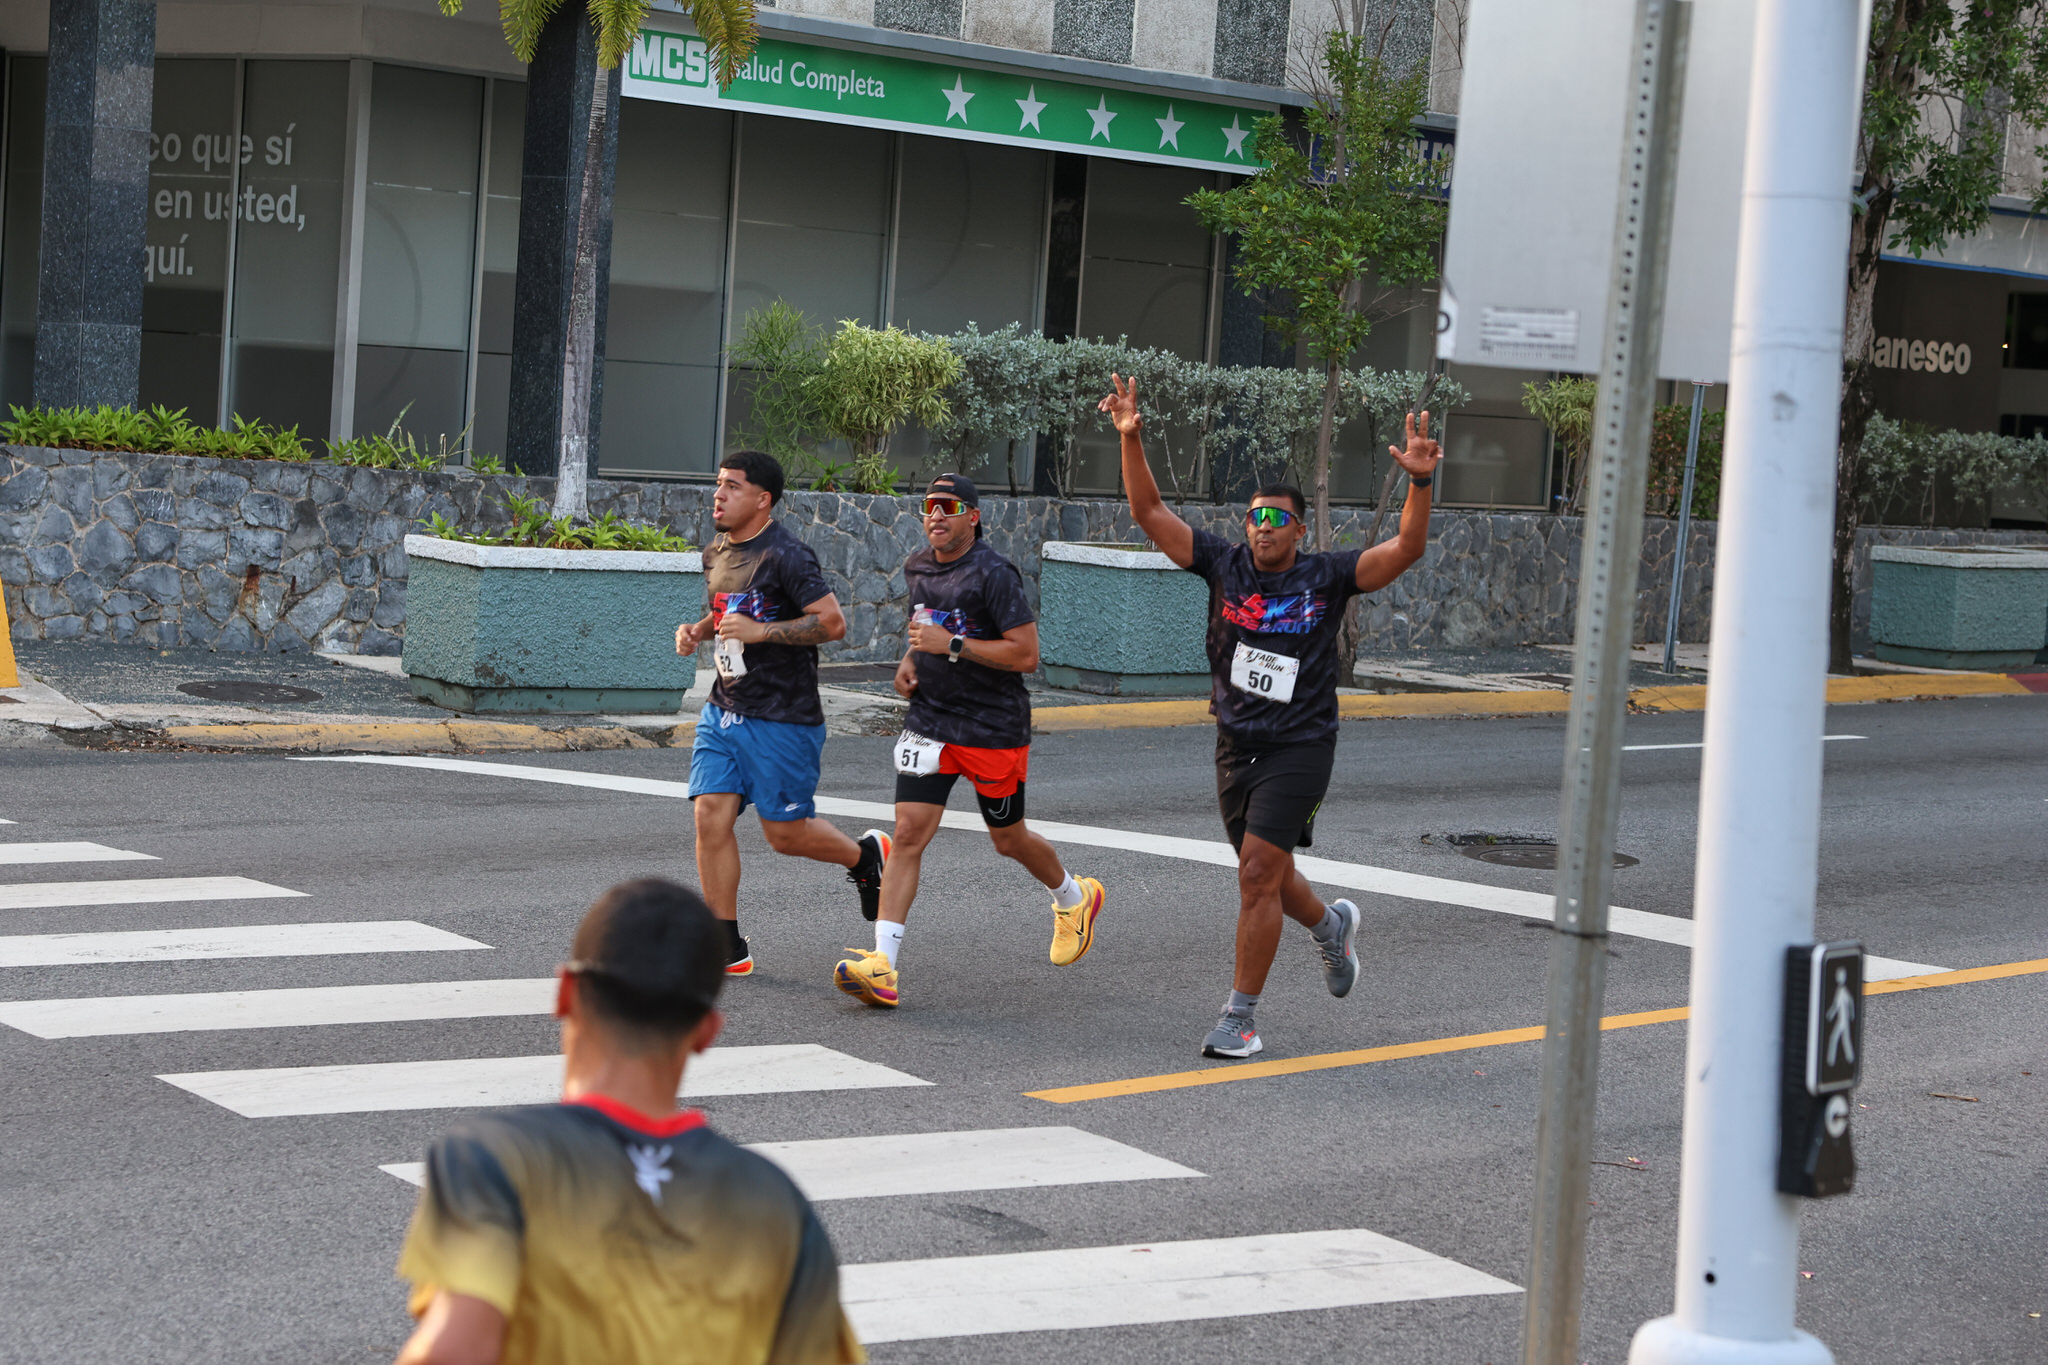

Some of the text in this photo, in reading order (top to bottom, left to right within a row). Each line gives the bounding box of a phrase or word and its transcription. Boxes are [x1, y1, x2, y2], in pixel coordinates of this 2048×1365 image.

[632, 34, 707, 83] MCS
[789, 61, 886, 100] Completa
[192, 133, 254, 172] que
[265, 123, 296, 166] sí
[154, 189, 193, 219] en
[1248, 669, 1273, 692] 50
[901, 749, 920, 768] 51
